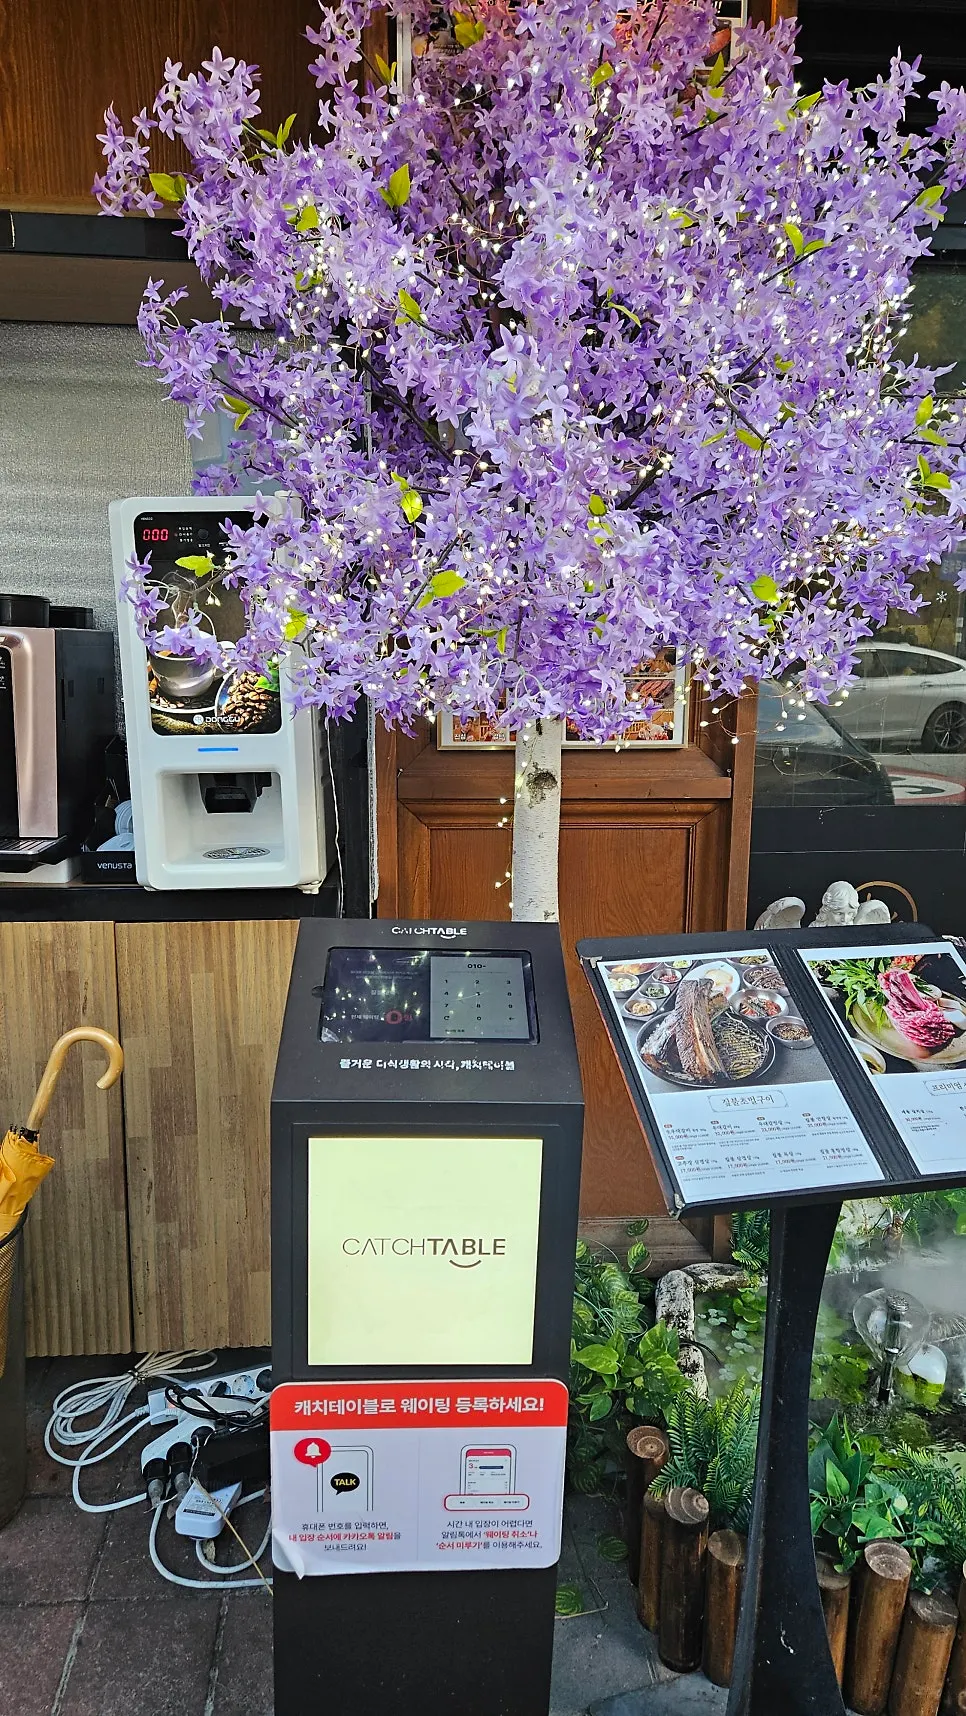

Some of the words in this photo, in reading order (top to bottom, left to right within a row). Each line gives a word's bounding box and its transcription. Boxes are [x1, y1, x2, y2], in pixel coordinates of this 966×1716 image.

[142, 528, 169, 541] 000
[391, 926, 468, 936] CATCHTABLE
[339, 1058, 373, 1069] 즐거운
[342, 1238, 506, 1257] CATCHTABLE
[294, 1398, 397, 1416] 캐치테이블로
[400, 1397, 451, 1414] 웨이팅
[455, 1396, 545, 1413] 등록하세요!
[334, 1477, 356, 1487] TALK
[302, 1522, 326, 1531] 휴대폰
[328, 1522, 352, 1530] 번호를
[354, 1521, 389, 1531] 입력하면,
[447, 1520, 463, 1528] 시간
[465, 1520, 473, 1528] 내
[475, 1520, 499, 1528] 입장이
[501, 1519, 533, 1528] 어렵다면
[289, 1533, 297, 1541] 내
[298, 1533, 315, 1542] 입장
[316, 1532, 342, 1541] 순서에
[343, 1532, 375, 1541] 카카오톡
[377, 1531, 401, 1540] 알림을
[441, 1531, 481, 1539] 알림톡에서
[324, 1543, 367, 1551] 보내드려요!
[492, 1541, 543, 1549] 이용해주세요.
